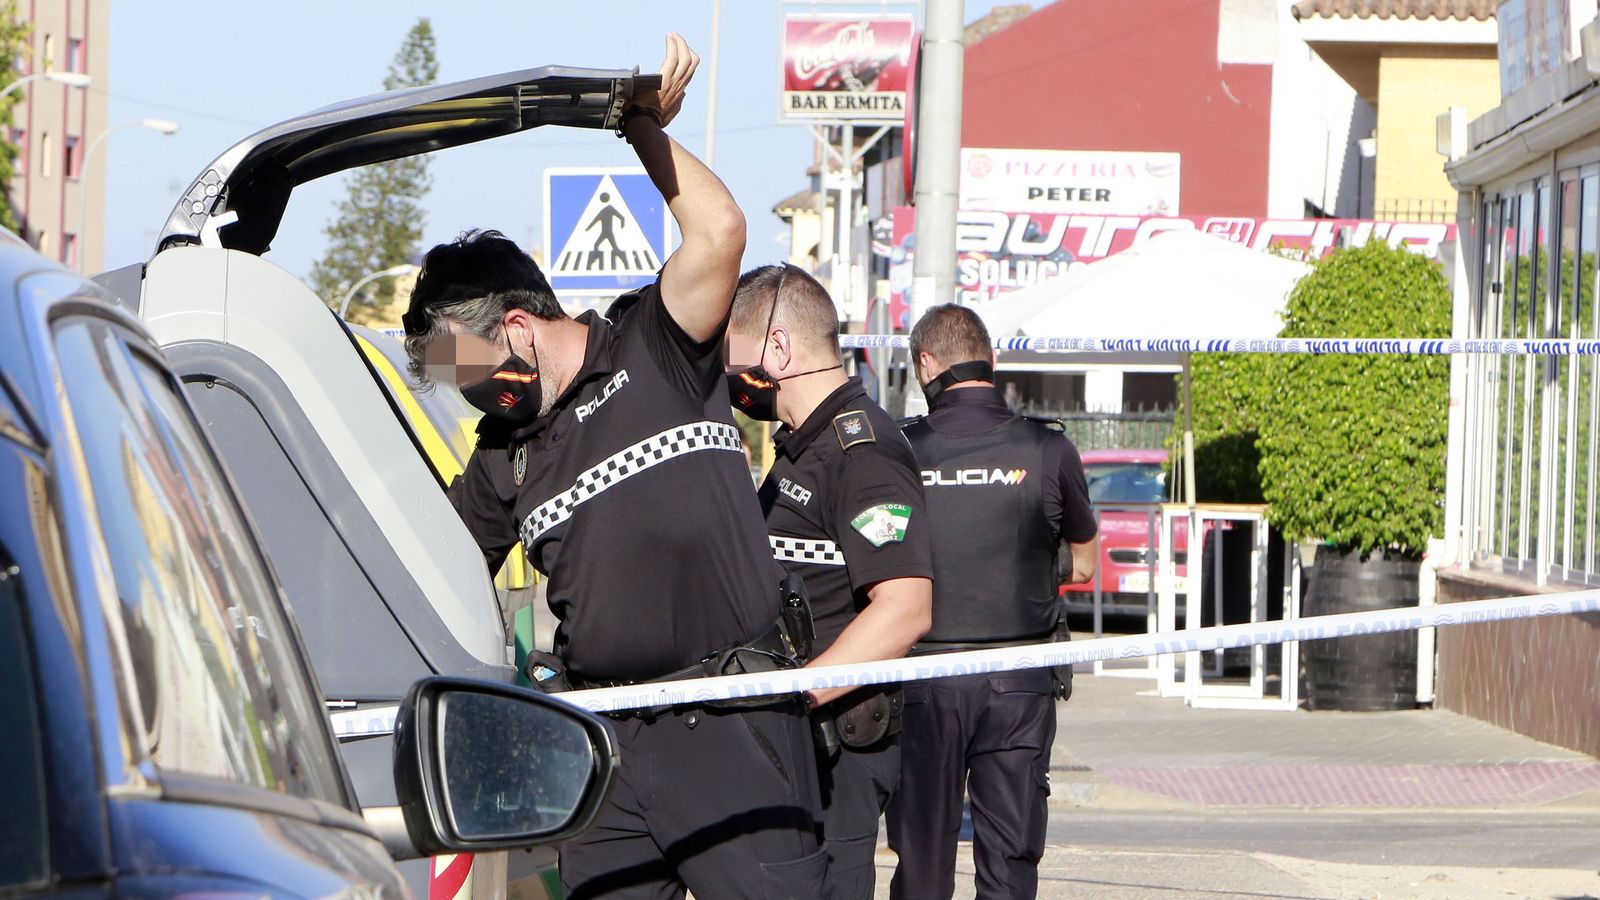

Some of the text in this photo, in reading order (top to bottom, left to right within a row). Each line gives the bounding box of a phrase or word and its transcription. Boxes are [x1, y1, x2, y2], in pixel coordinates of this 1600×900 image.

[792, 95, 903, 110] BAR ERMITA
[1006, 161, 1137, 178] PIZZERIA
[1028, 186, 1112, 202] PETER
[959, 258, 1087, 288] SOLUCI
[575, 369, 630, 423] POLICIA
[921, 468, 1006, 486] OLICIA
[778, 477, 812, 506] POLICIA
